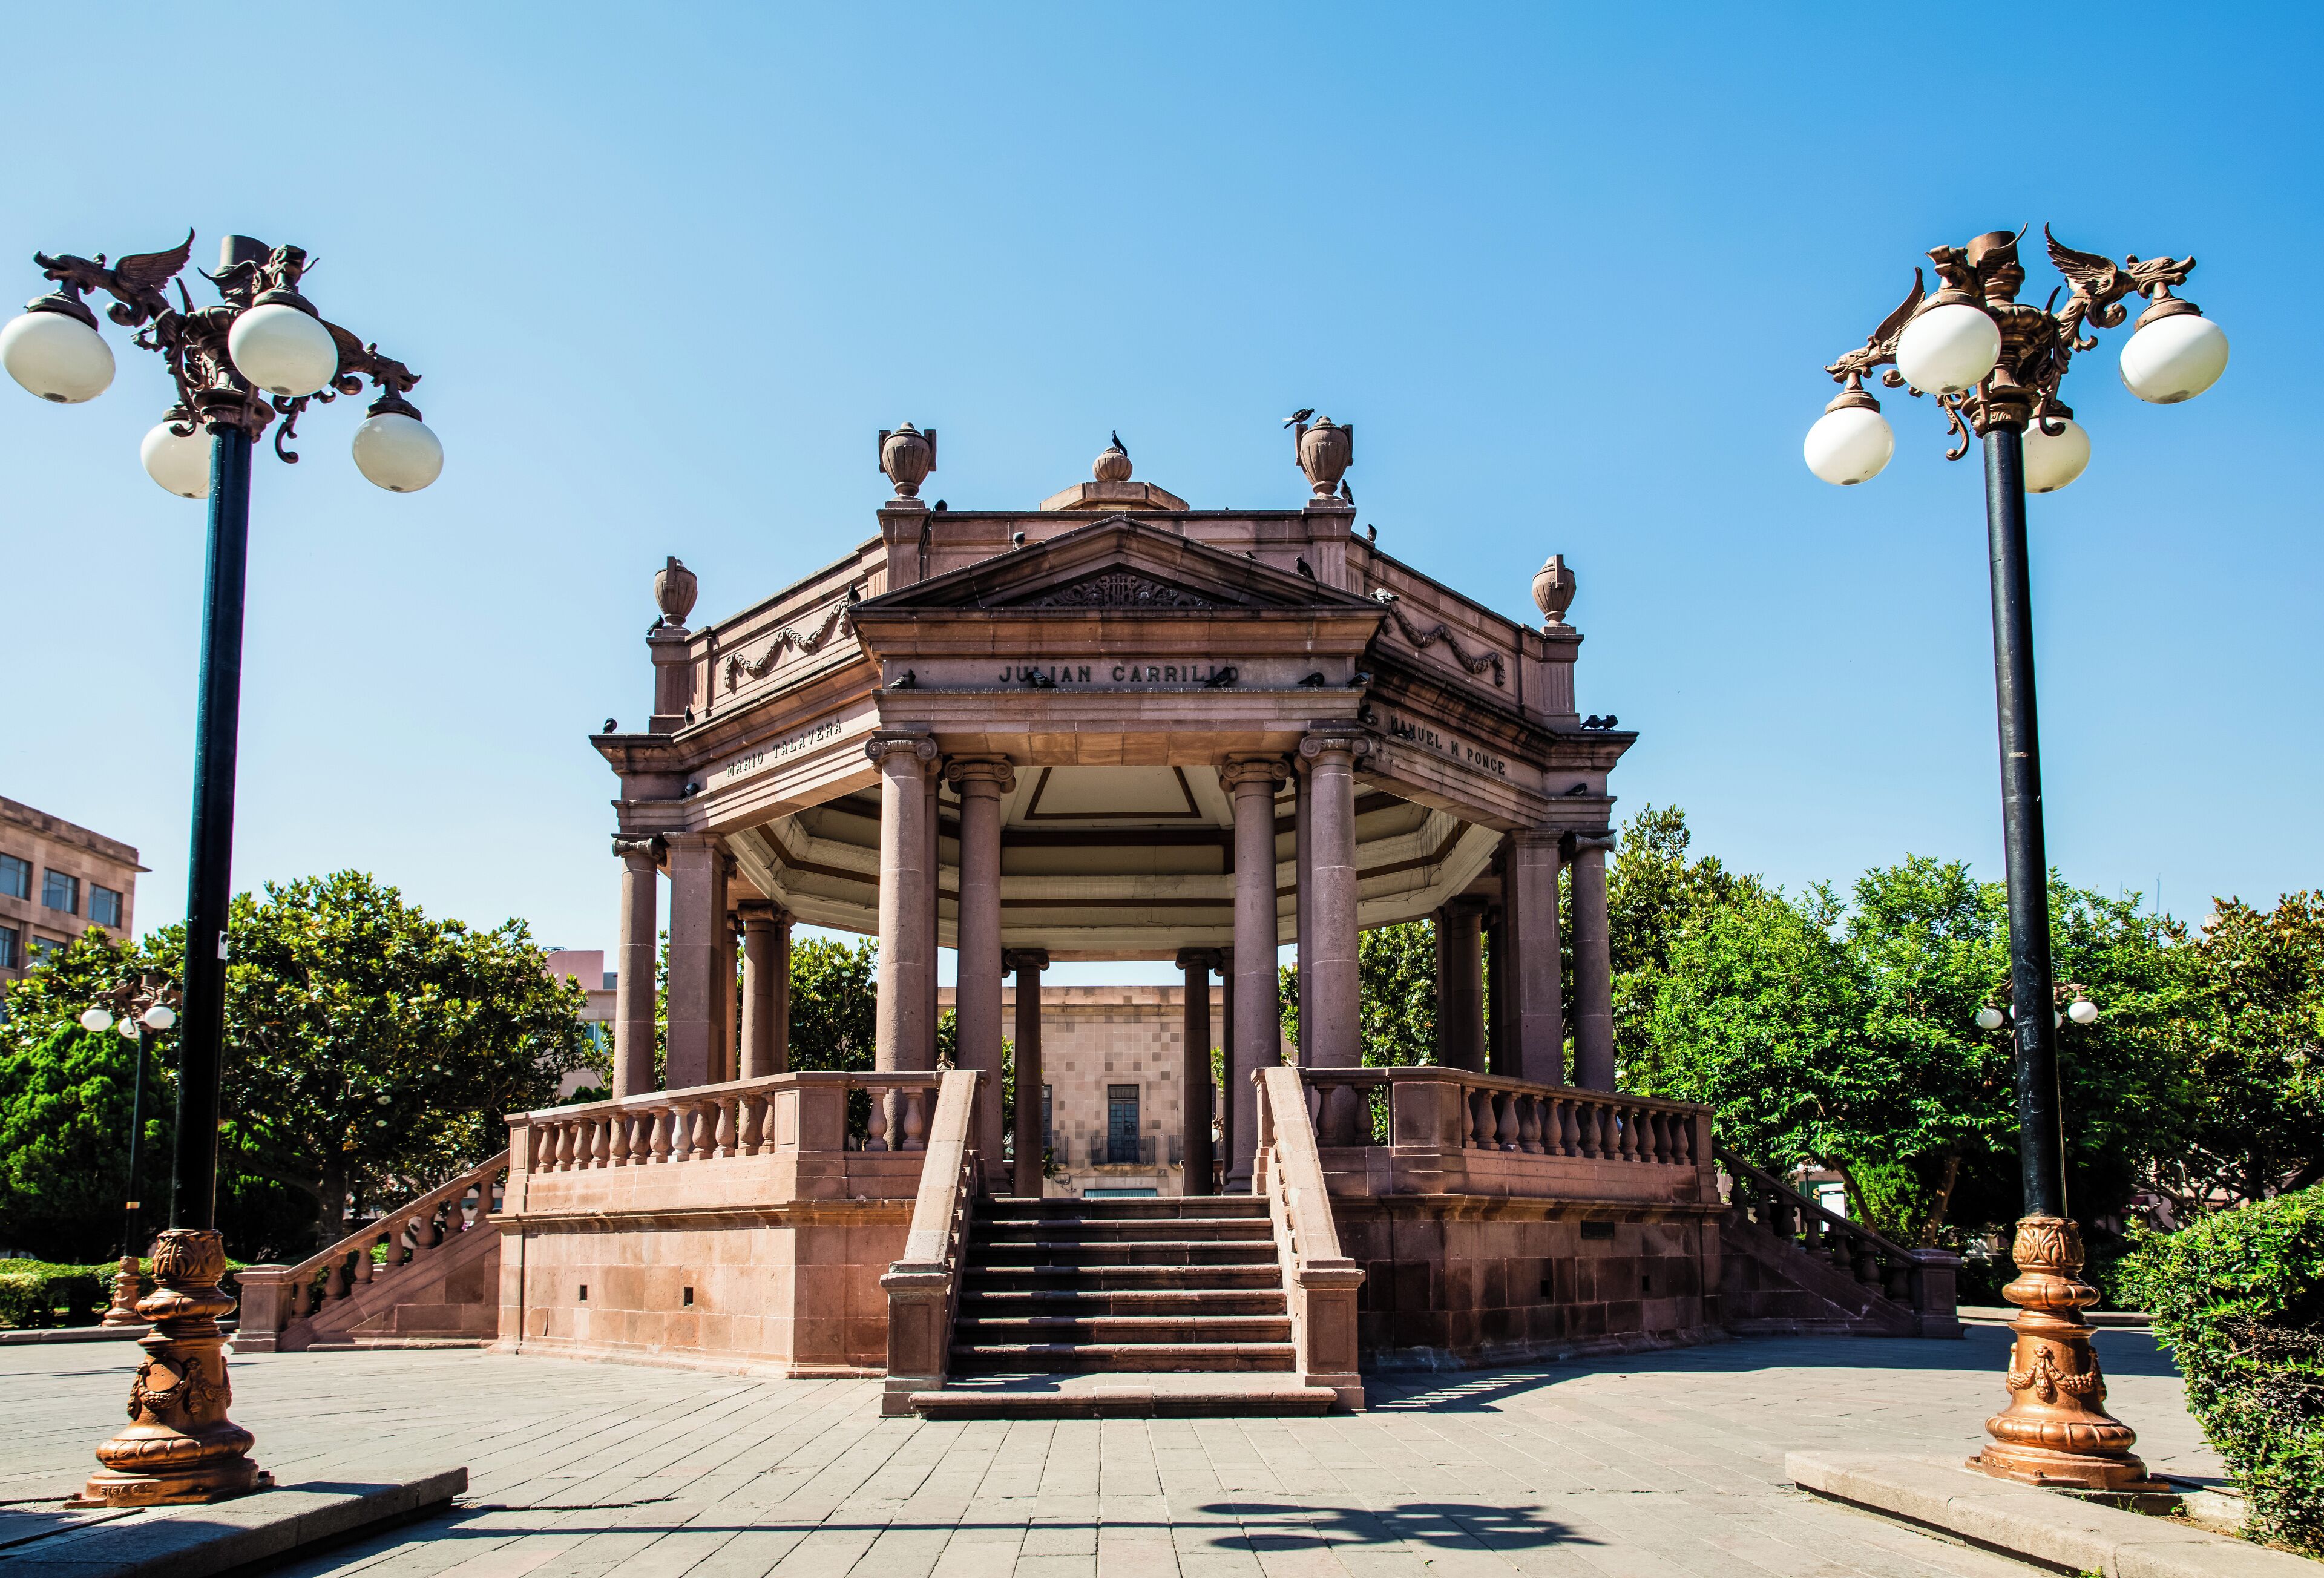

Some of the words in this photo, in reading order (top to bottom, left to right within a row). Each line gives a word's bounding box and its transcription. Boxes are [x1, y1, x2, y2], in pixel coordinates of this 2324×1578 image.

[999, 666, 1091, 682] JUIAN
[726, 751, 763, 777] MARIO
[773, 719, 841, 758] TALAVERA
[1467, 748, 1505, 775] PONCE
